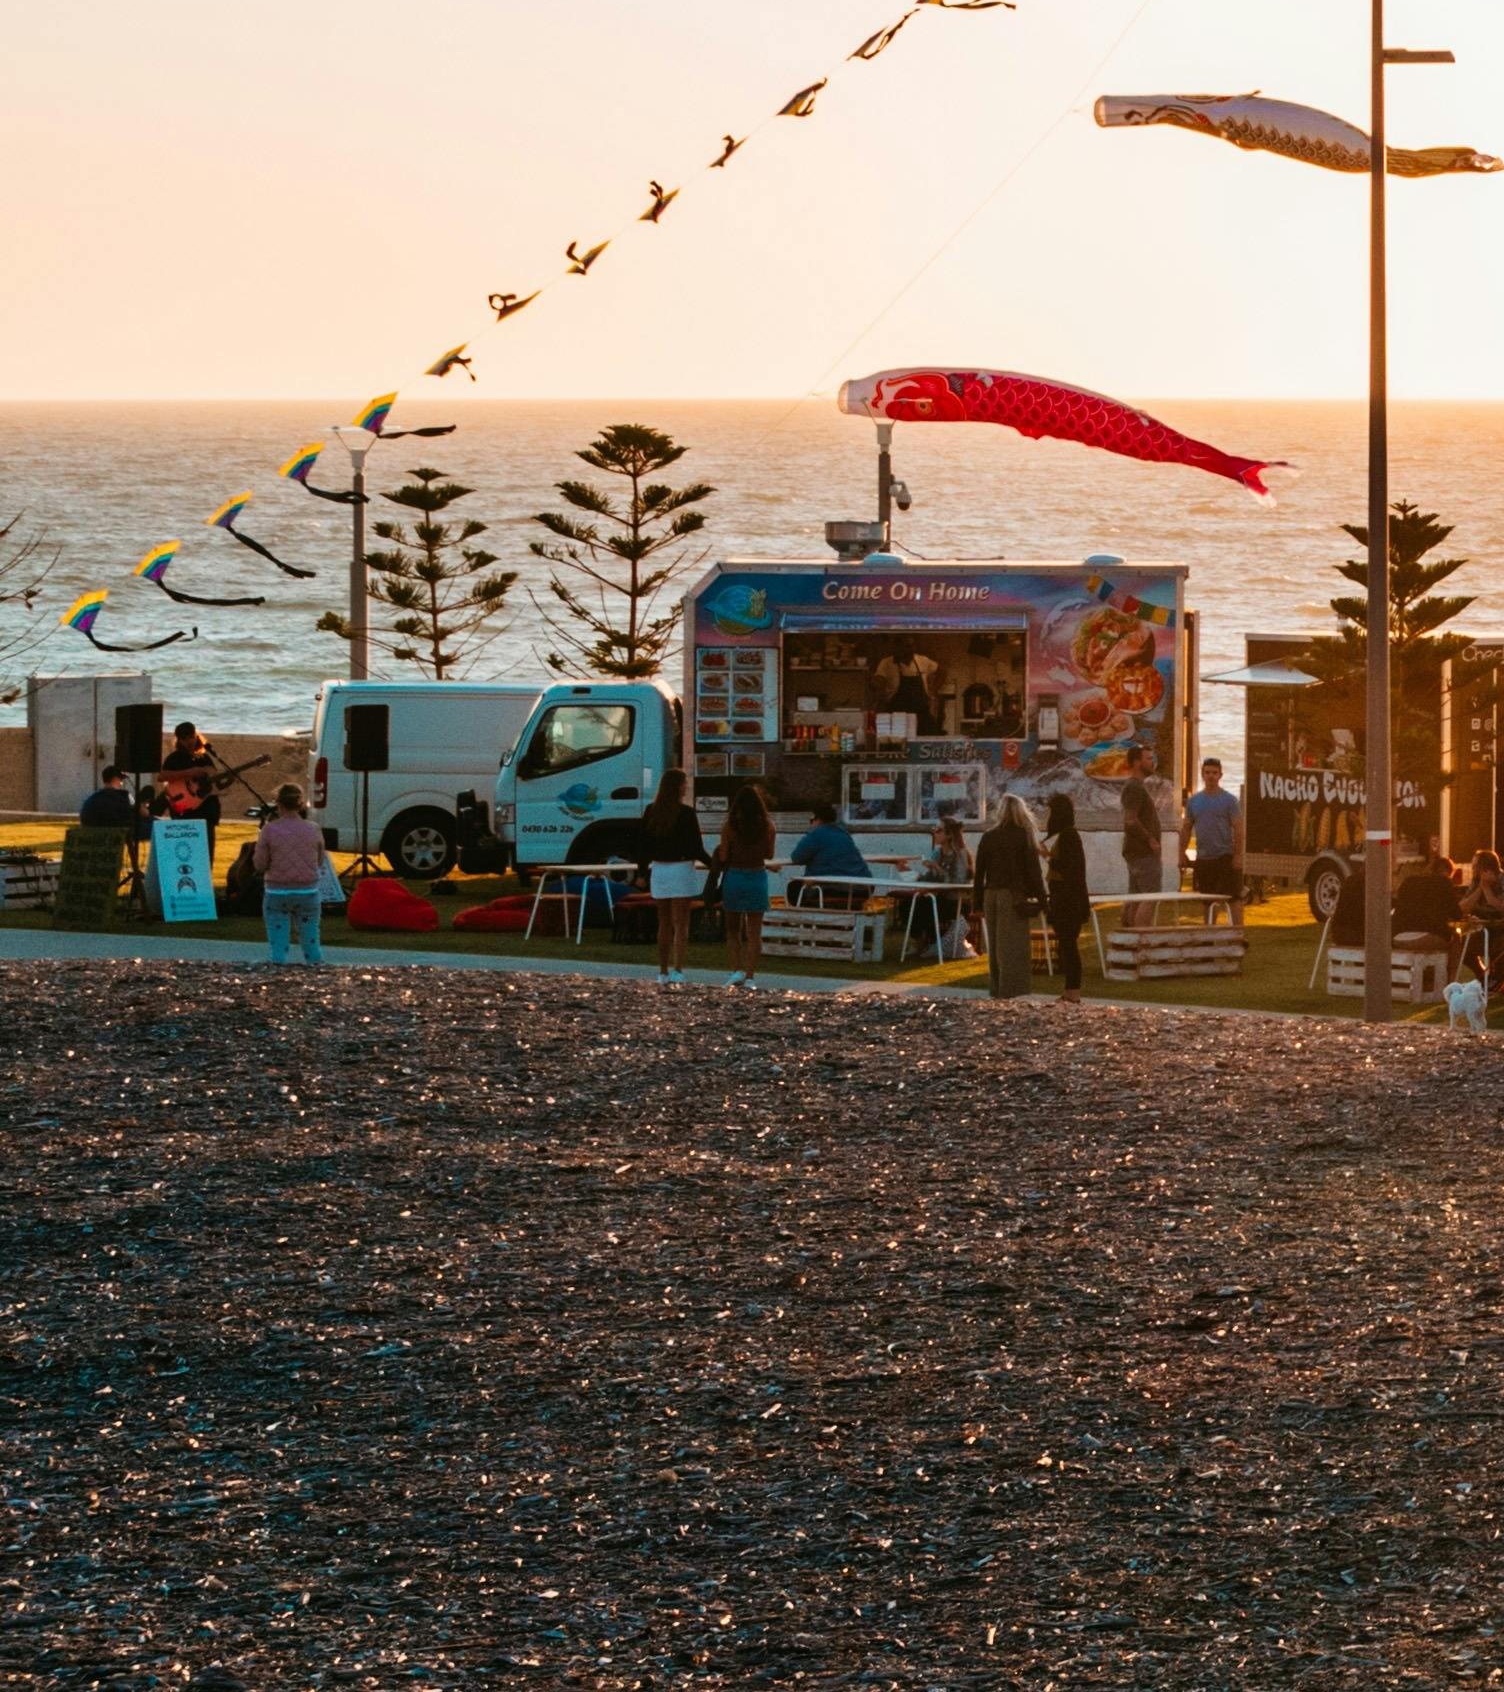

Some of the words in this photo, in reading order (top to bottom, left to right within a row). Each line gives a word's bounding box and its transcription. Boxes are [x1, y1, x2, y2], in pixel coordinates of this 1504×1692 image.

[822, 581, 883, 600] Come
[889, 581, 922, 600] On
[928, 582, 990, 600] Home
[1259, 770, 1319, 803] NACHO
